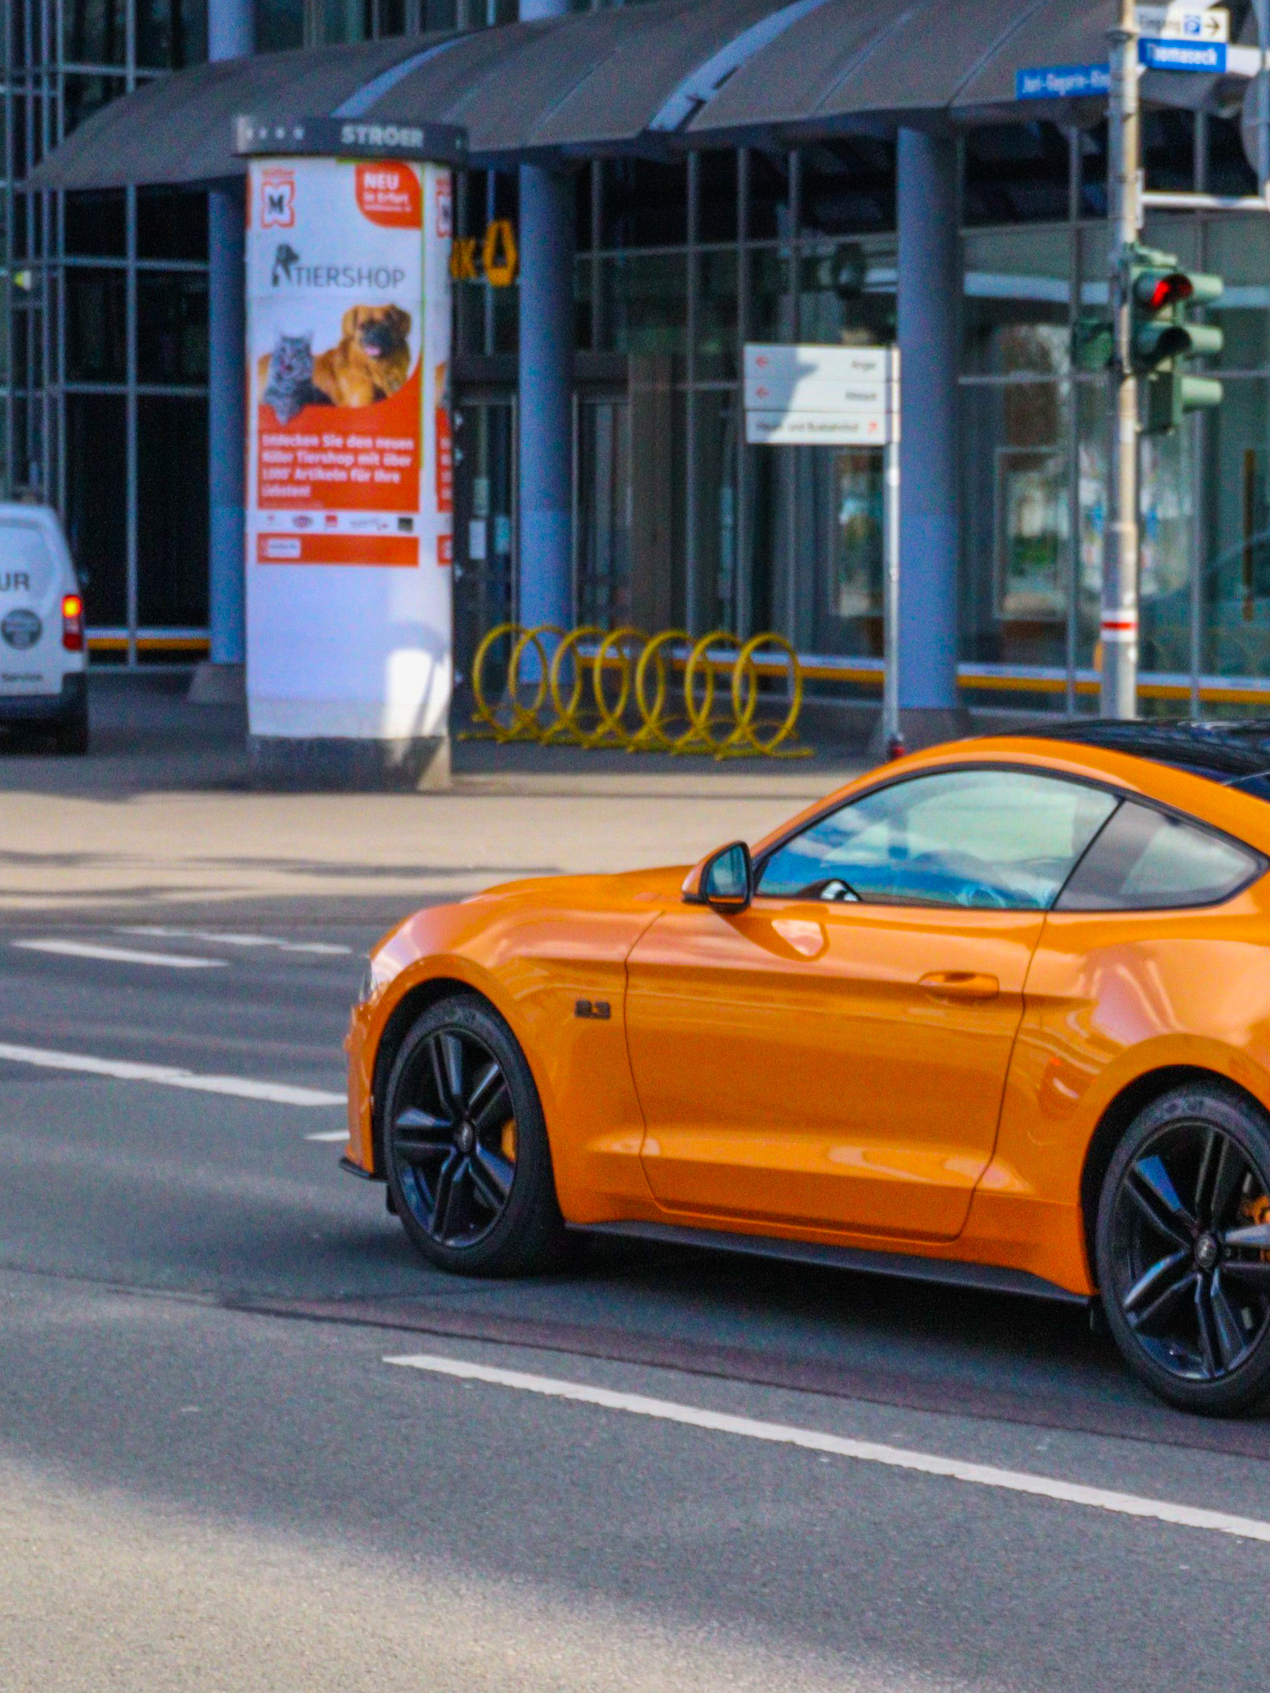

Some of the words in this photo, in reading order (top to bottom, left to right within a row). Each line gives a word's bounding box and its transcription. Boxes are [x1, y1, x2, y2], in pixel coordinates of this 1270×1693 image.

[1147, 43, 1218, 66] Thomaseck
[363, 172, 400, 190] NEU
[295, 267, 406, 289] TIERSHOP
[297, 451, 355, 467] Tiershop
